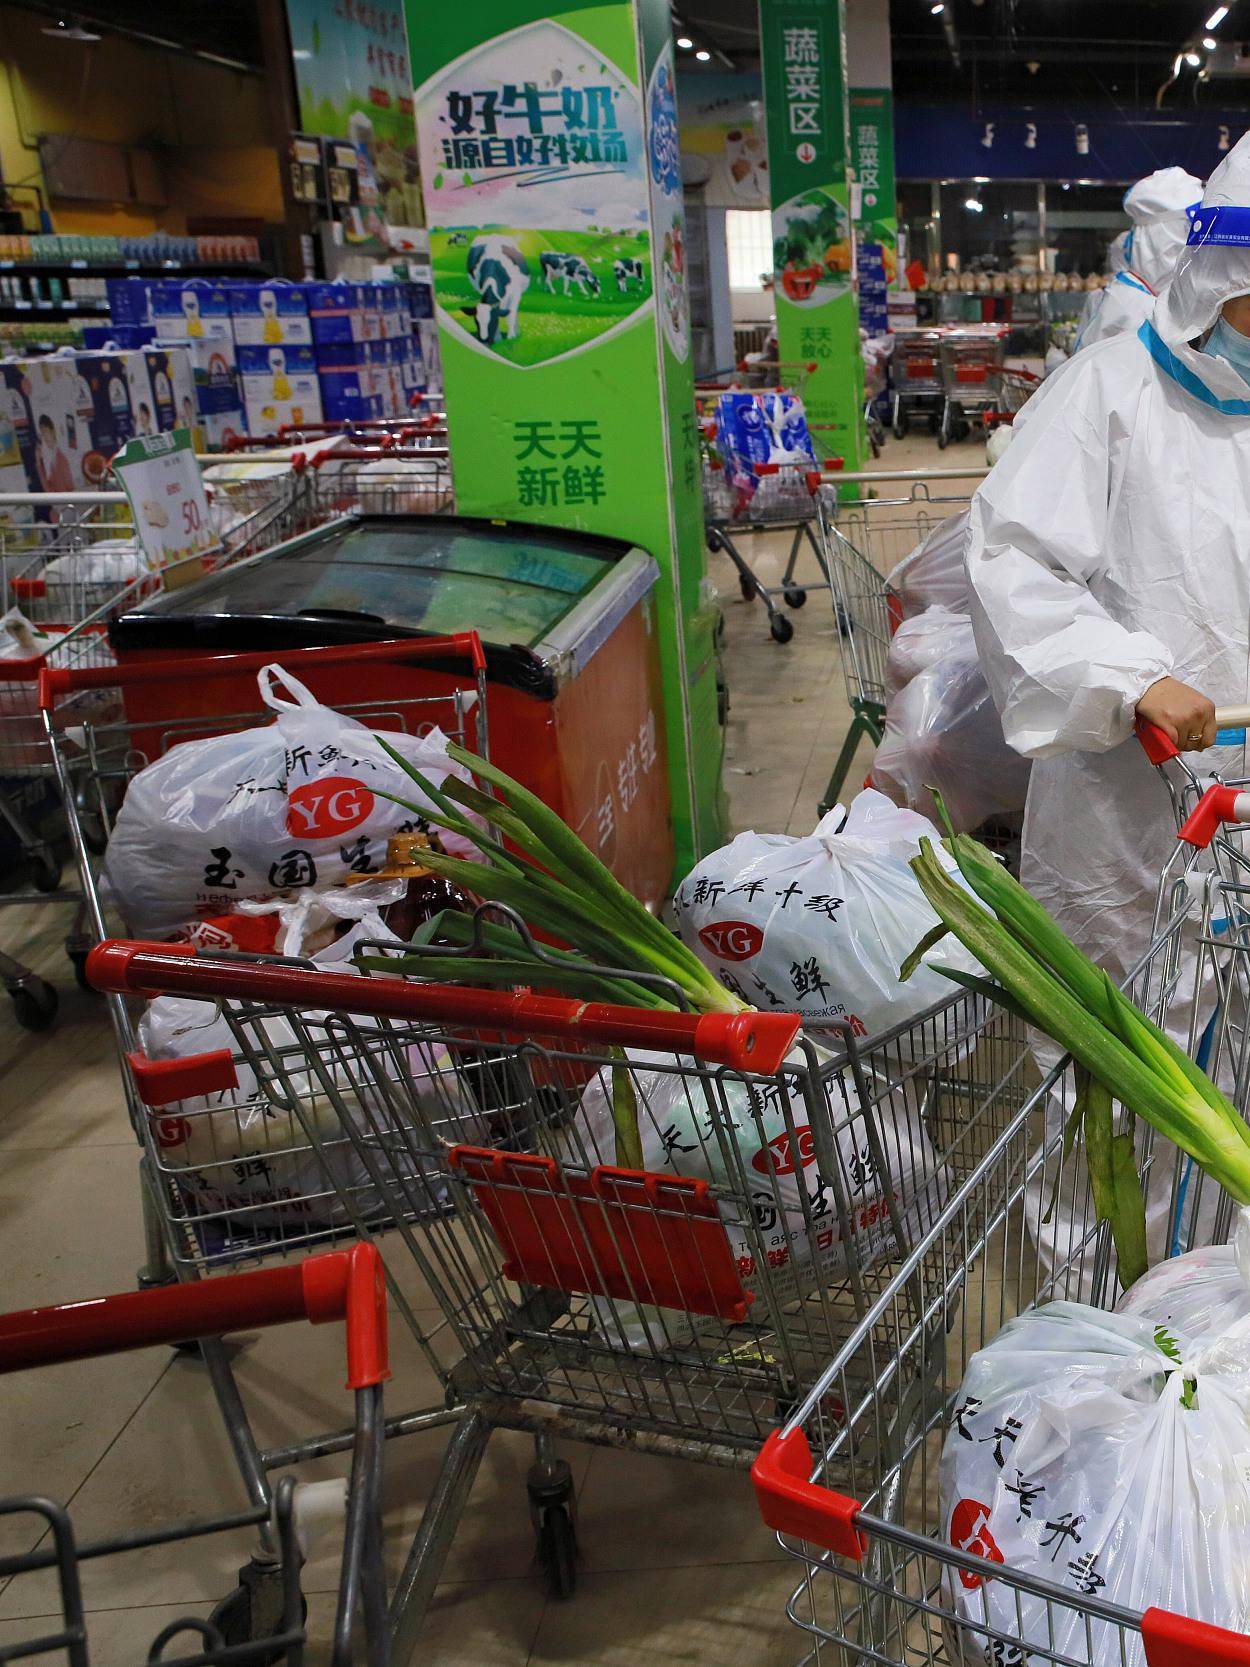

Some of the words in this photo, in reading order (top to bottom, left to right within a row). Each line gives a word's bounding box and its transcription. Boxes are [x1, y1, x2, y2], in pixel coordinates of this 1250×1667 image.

[784, 27, 822, 135] 蔬菜区
[446, 82, 619, 135] 好牛奶
[441, 131, 628, 170] 源自好牧场
[857, 125, 880, 190] 蔬菜区
[801, 326, 832, 342] 天天
[513, 421, 603, 460] 天天
[517, 465, 607, 506] 新鲜
[182, 499, 200, 534] 50
[290, 788, 362, 831] YG
[703, 927, 752, 954] YG
